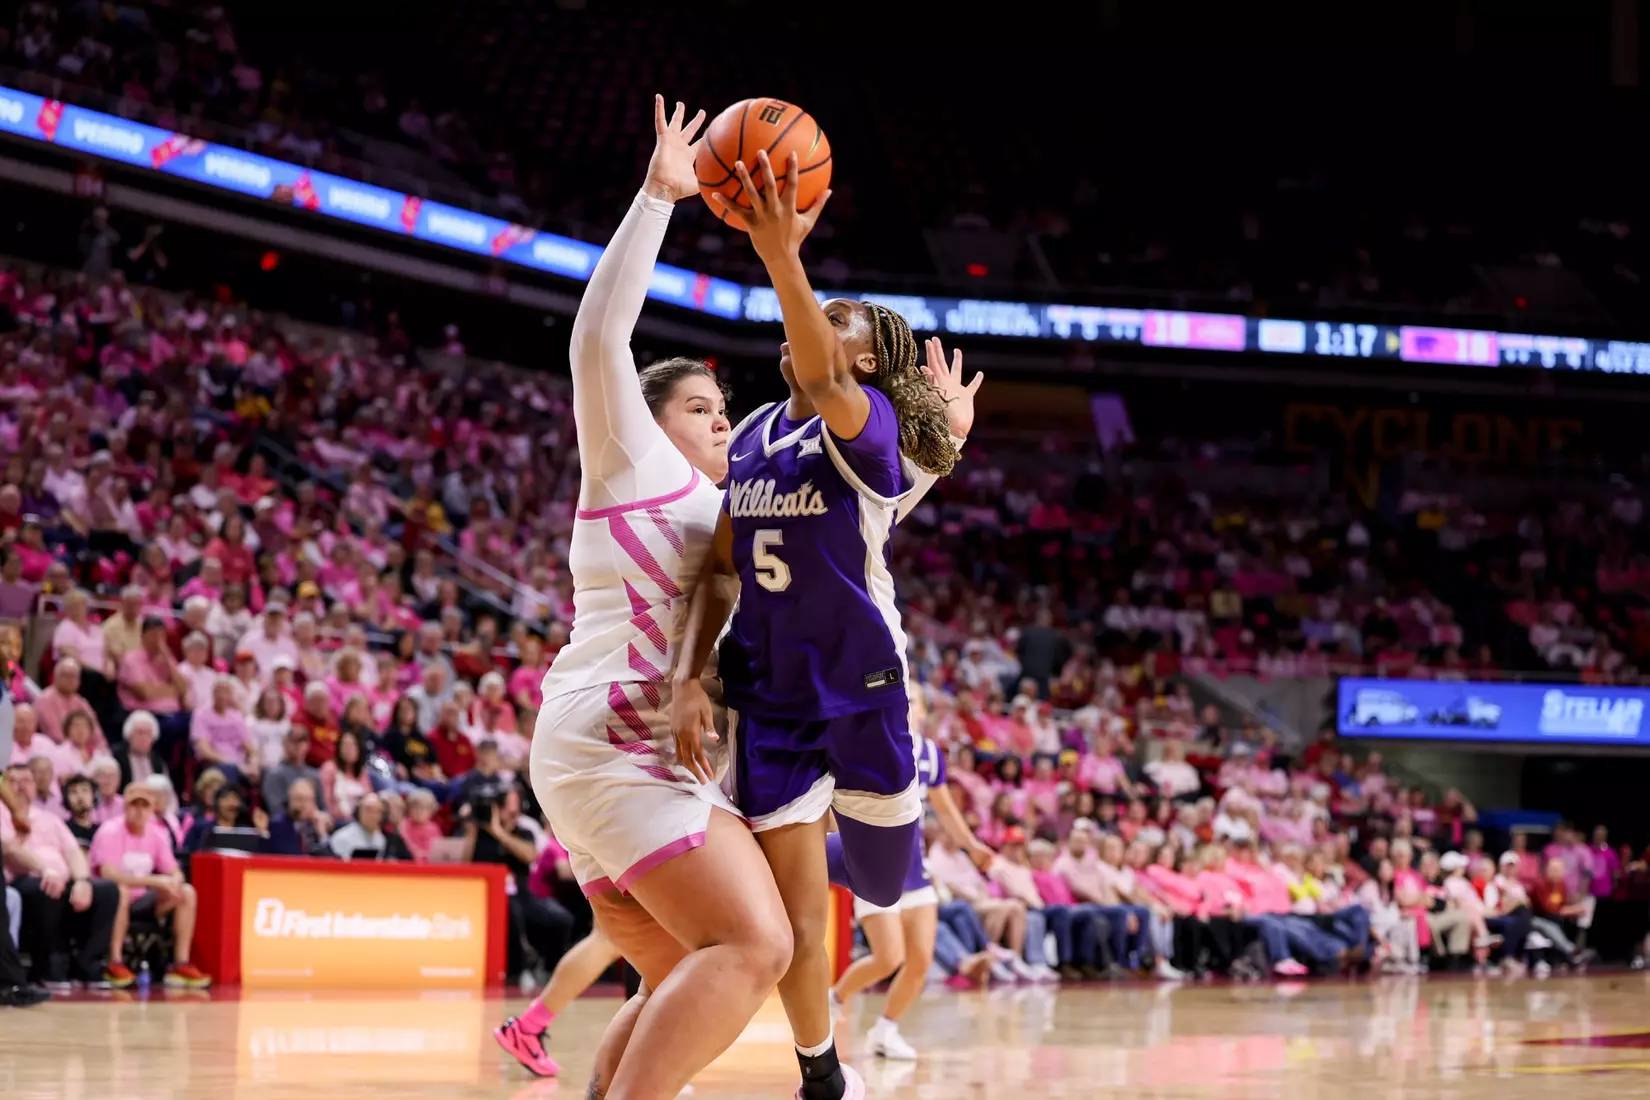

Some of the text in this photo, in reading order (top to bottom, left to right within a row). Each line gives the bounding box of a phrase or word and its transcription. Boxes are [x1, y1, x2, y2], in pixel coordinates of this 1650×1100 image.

[1315, 322, 1378, 357] 1:17
[729, 478, 829, 518] Wildcats
[752, 528, 793, 593] 5
[282, 910, 331, 938] First
